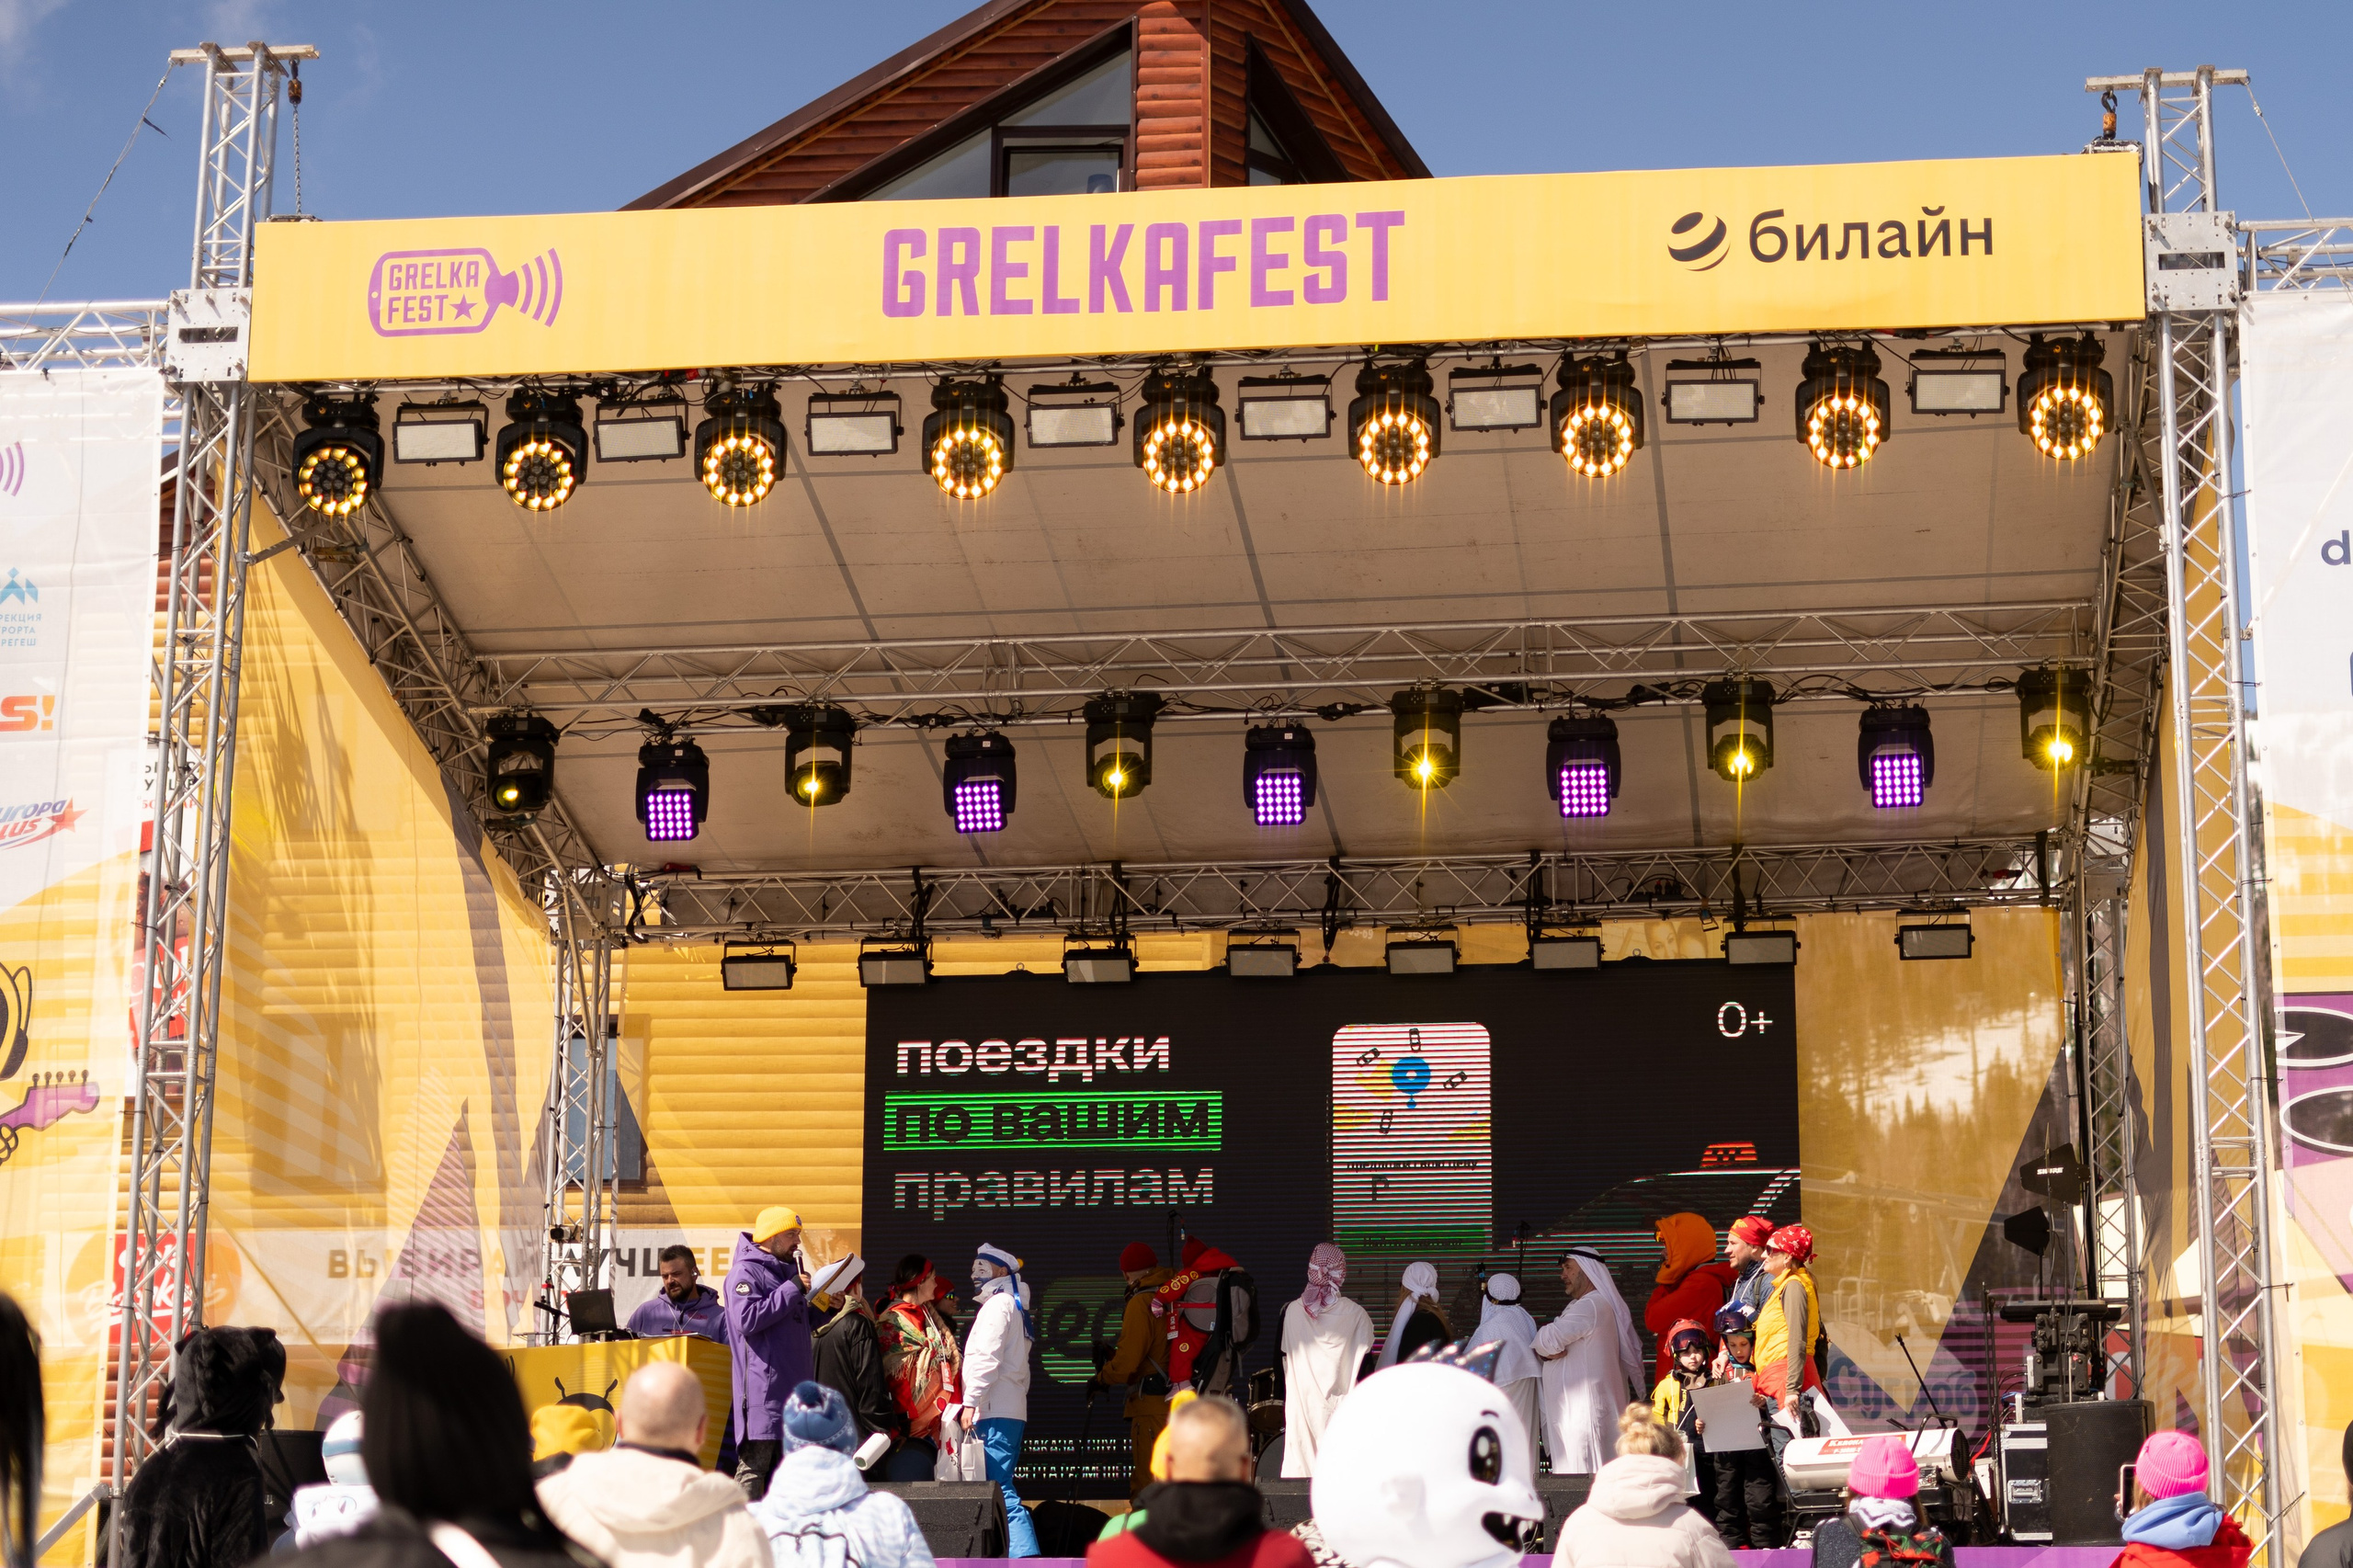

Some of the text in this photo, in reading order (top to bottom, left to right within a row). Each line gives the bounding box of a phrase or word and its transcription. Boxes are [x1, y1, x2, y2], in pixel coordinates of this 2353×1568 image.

[1749, 205, 1994, 264] билайн
[388, 260, 481, 291] GRELKA
[881, 210, 1405, 318] GRELKAFEST
[387, 294, 449, 324] FEST
[1717, 1001, 1774, 1038] 0+
[896, 1037, 1170, 1083] поездки
[895, 1102, 1210, 1143] по вашим
[894, 1168, 1214, 1221] правилам
